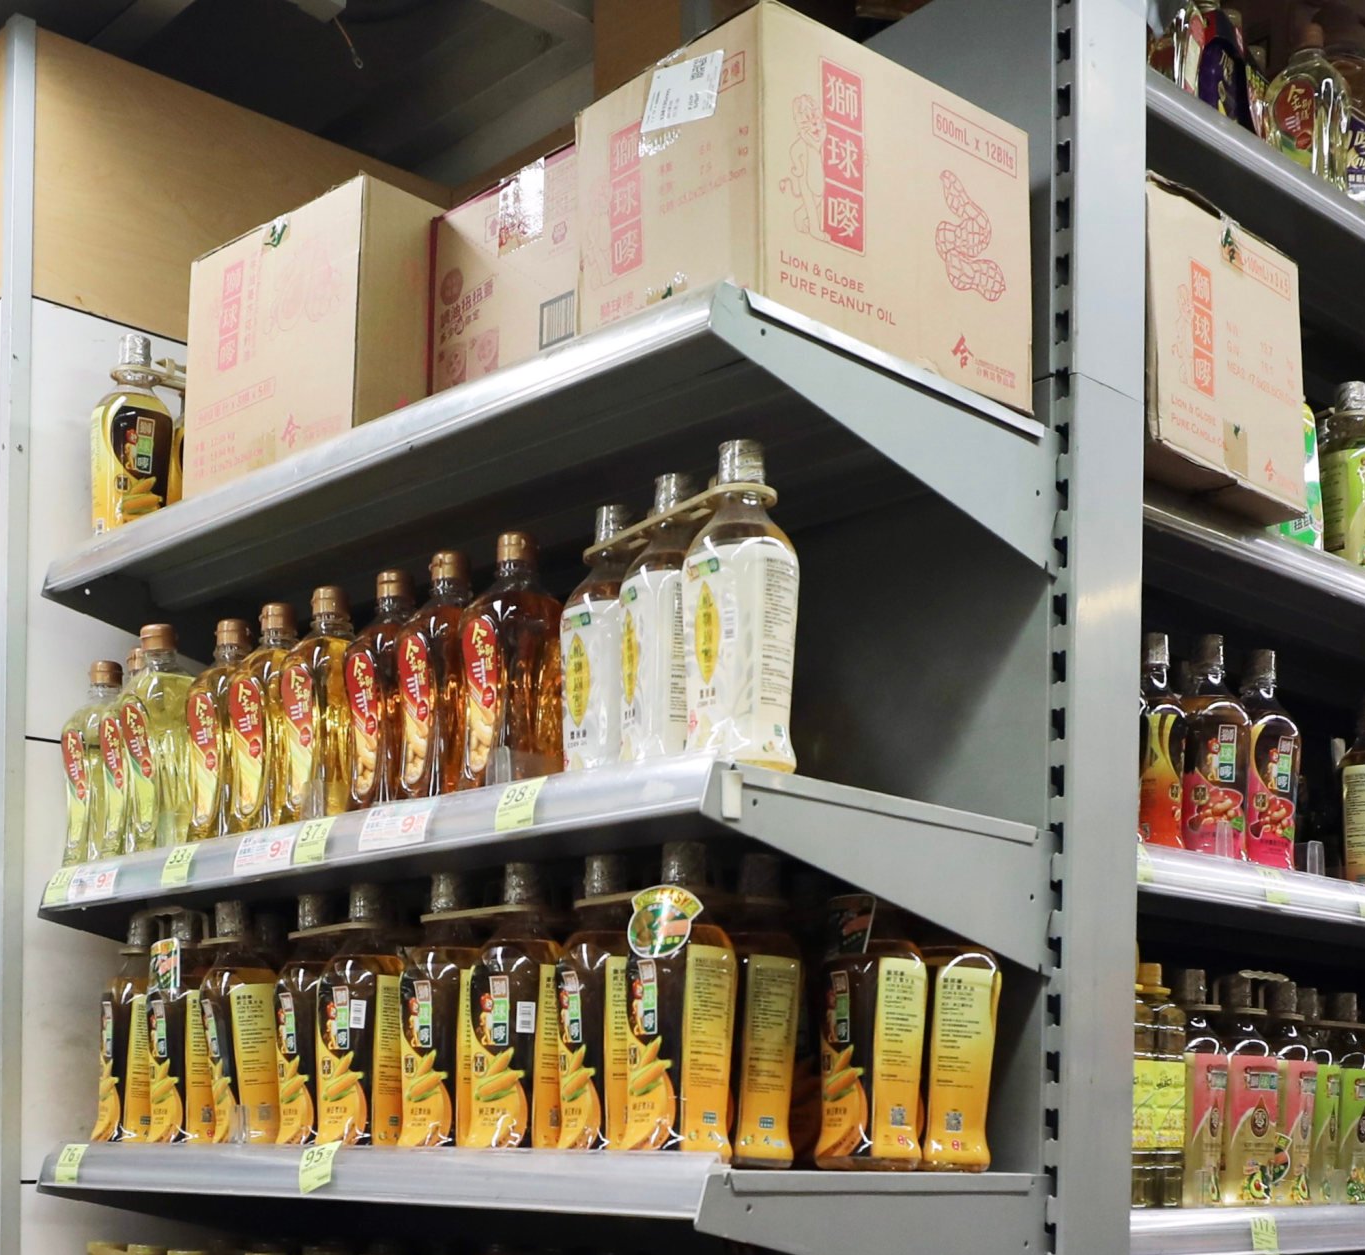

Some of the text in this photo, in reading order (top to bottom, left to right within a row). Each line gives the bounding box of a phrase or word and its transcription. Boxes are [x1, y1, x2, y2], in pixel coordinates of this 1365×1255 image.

[826, 72, 860, 238] 獅球嘜
[936, 114, 970, 146] 600mL
[813, 262, 821, 277] &
[780, 271, 897, 327] PURE PEANUT OIL
[1193, 271, 1212, 389] 獅球嘜
